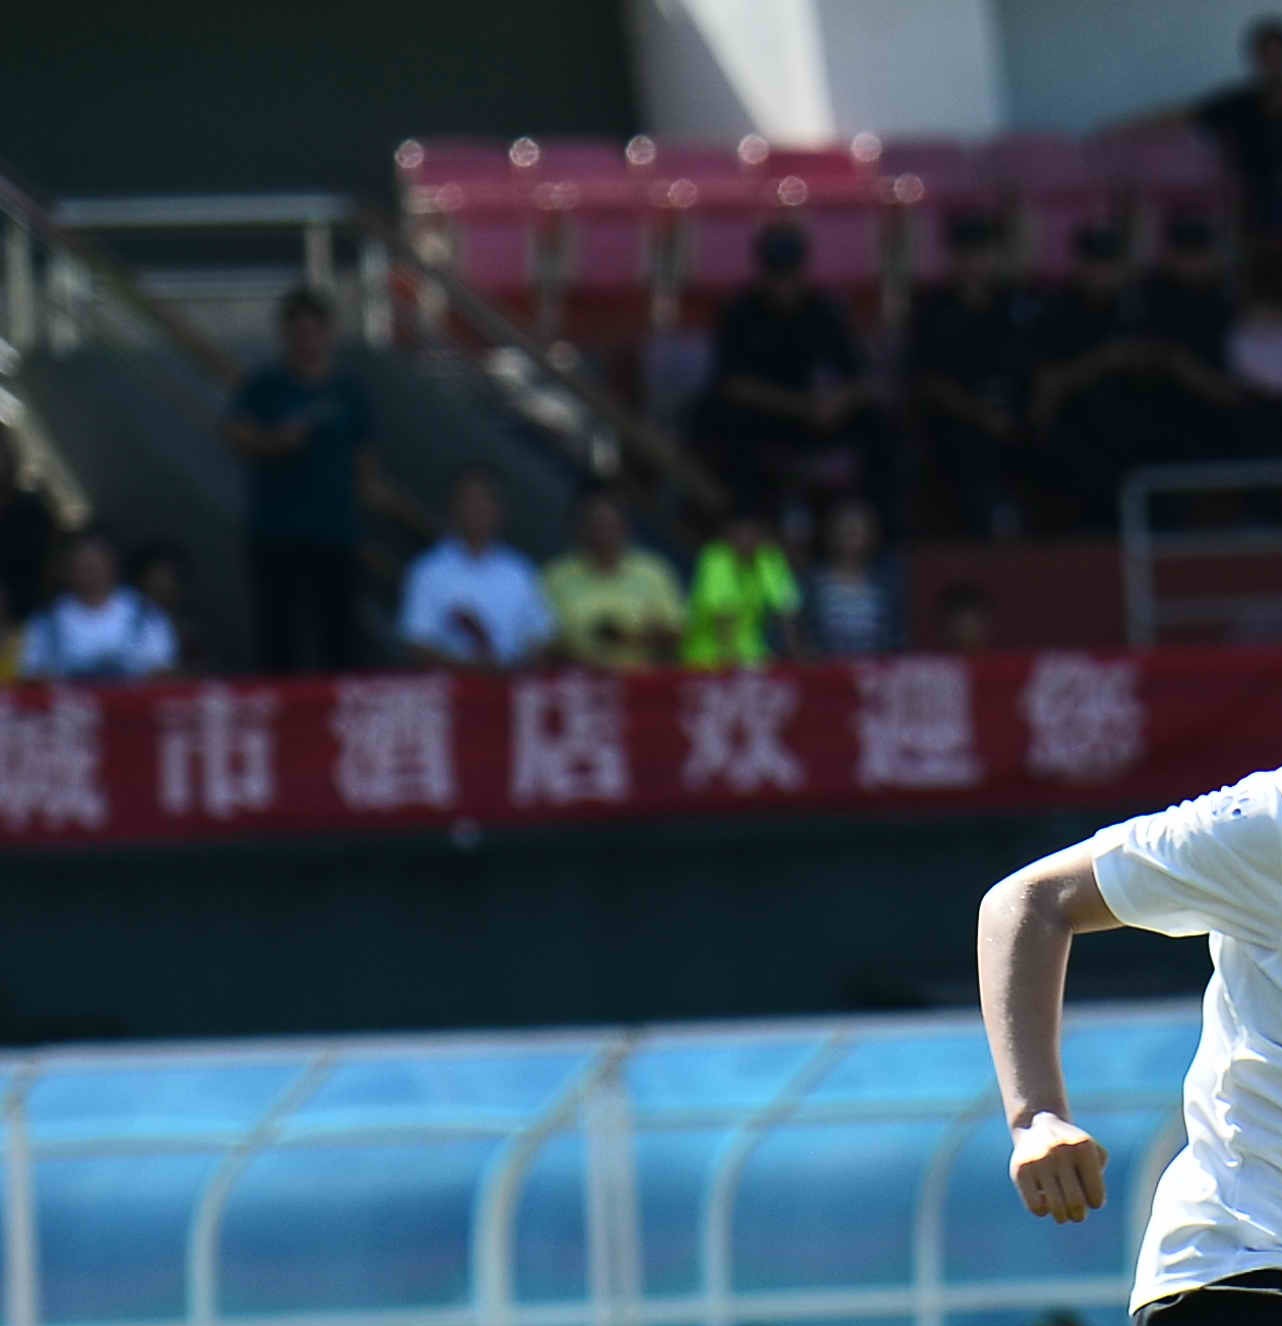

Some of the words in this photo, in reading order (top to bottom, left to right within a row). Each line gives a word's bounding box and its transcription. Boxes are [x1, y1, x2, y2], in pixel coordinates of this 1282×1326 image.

[0, 652, 1142, 832] 城市酒店欢迎您
